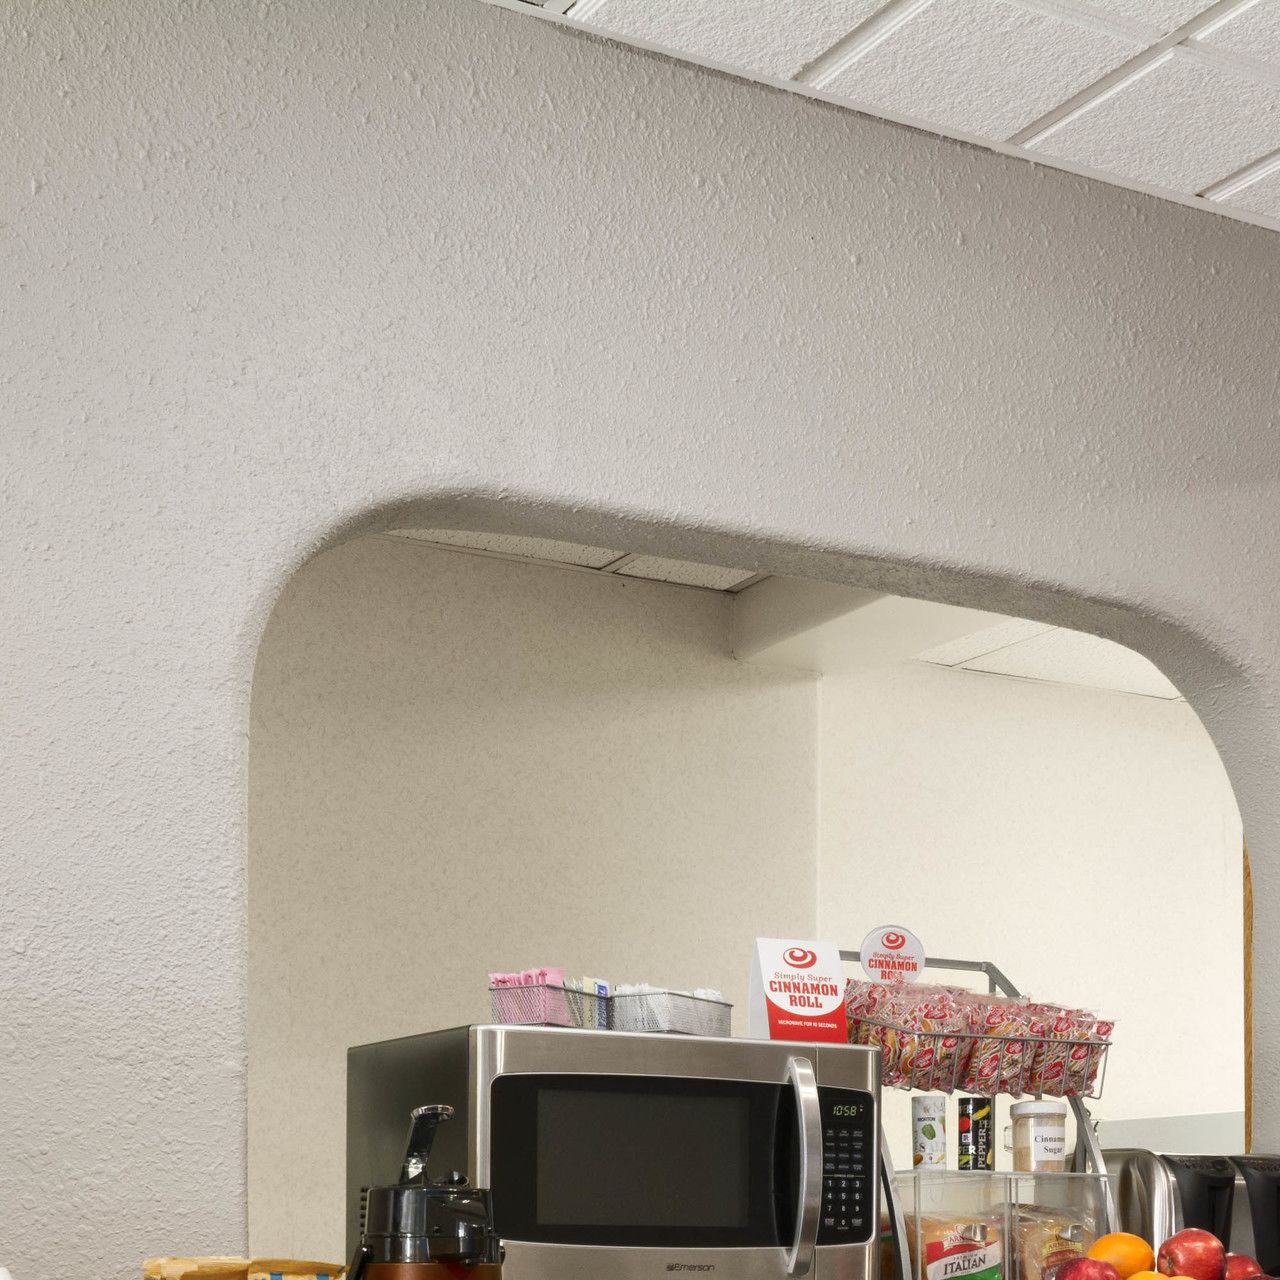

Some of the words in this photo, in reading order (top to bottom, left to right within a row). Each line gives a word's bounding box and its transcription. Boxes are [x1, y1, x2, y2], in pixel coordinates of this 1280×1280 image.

[868, 959, 918, 972] CINNAMON
[774, 971, 805, 982] Simply
[807, 973, 833, 984] Super
[769, 981, 839, 997] CINNAMON
[789, 995, 823, 1008] ROLL
[1044, 1146, 1062, 1154] Sugar
[949, 1235, 964, 1243] ARN
[674, 1263, 715, 1271] Emerson
[943, 1254, 986, 1275] ITALIAN
